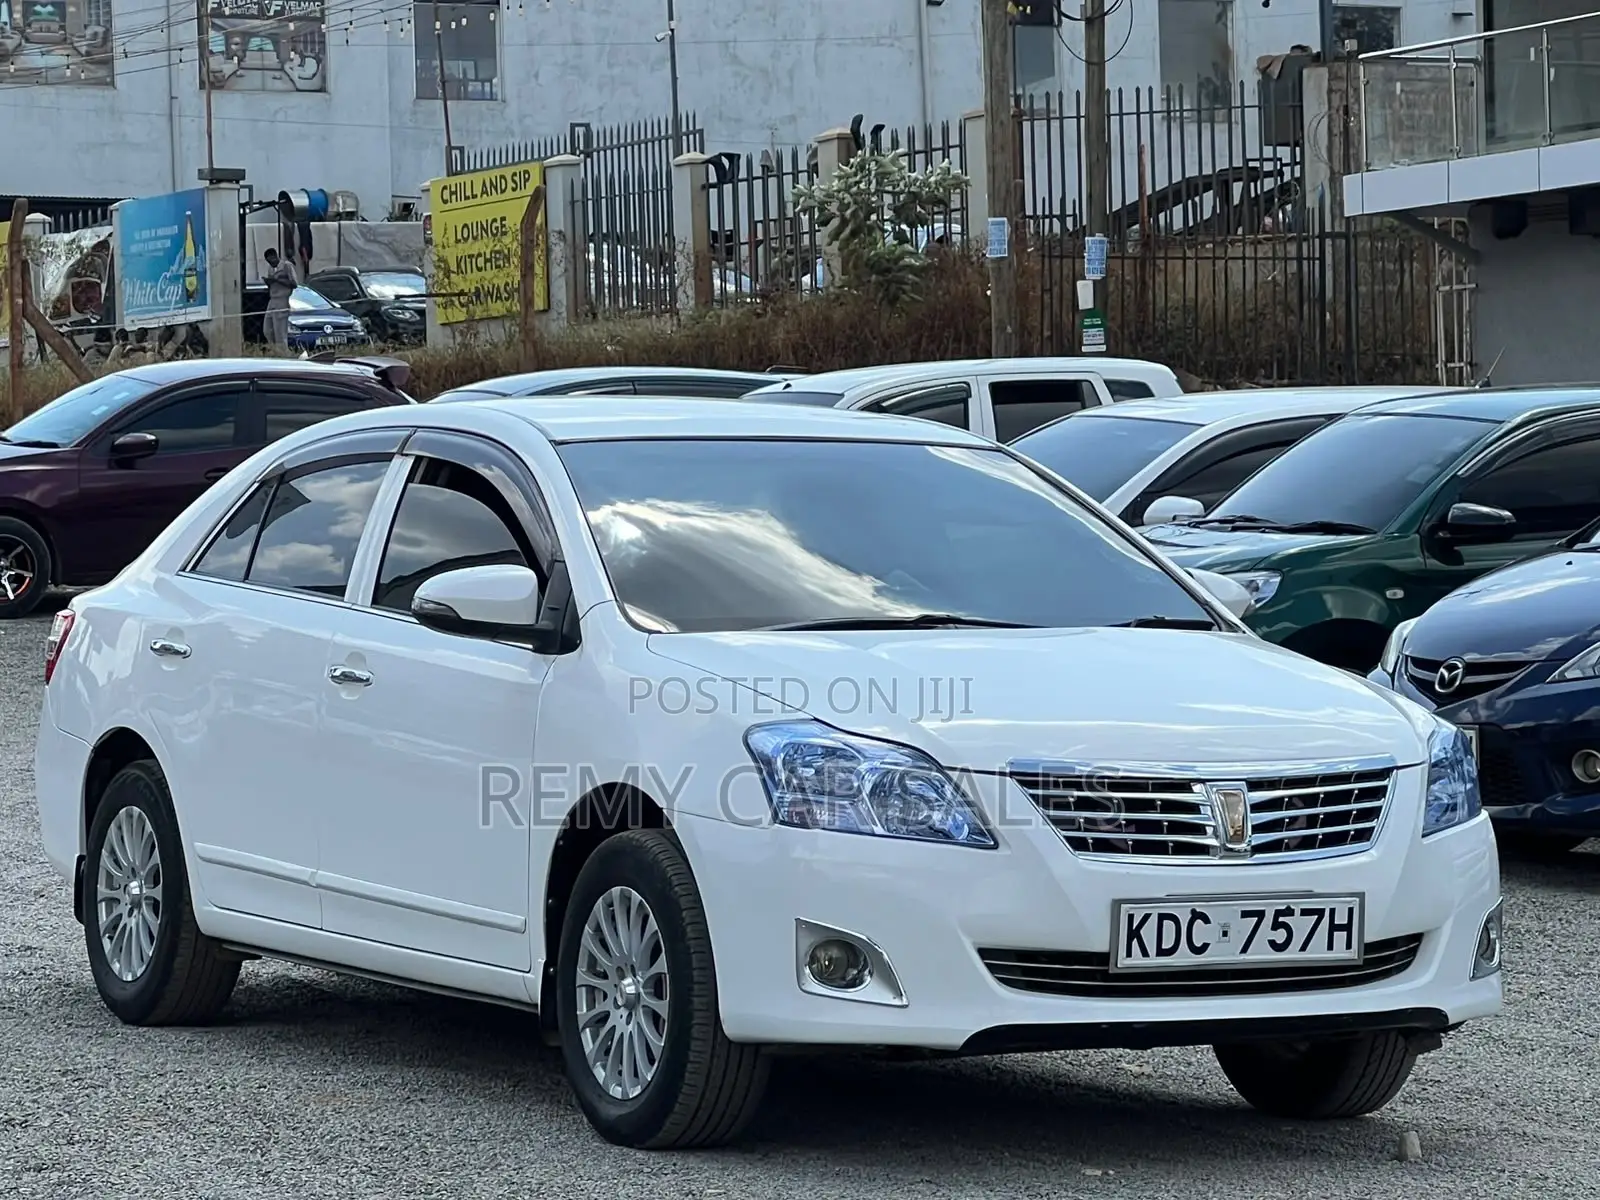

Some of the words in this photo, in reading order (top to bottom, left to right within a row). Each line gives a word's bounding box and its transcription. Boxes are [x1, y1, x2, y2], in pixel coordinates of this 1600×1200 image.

[284, 1, 321, 11] VELMAC
[440, 180, 478, 205] CHILL
[480, 174, 508, 196] AND
[511, 169, 531, 192] SIP
[454, 216, 508, 244] LOUNGE
[455, 248, 511, 276] KITCHEN
[122, 278, 156, 306] White
[157, 272, 183, 311] Cap
[1124, 909, 1212, 959] KDC
[1239, 904, 1355, 954] 757H
